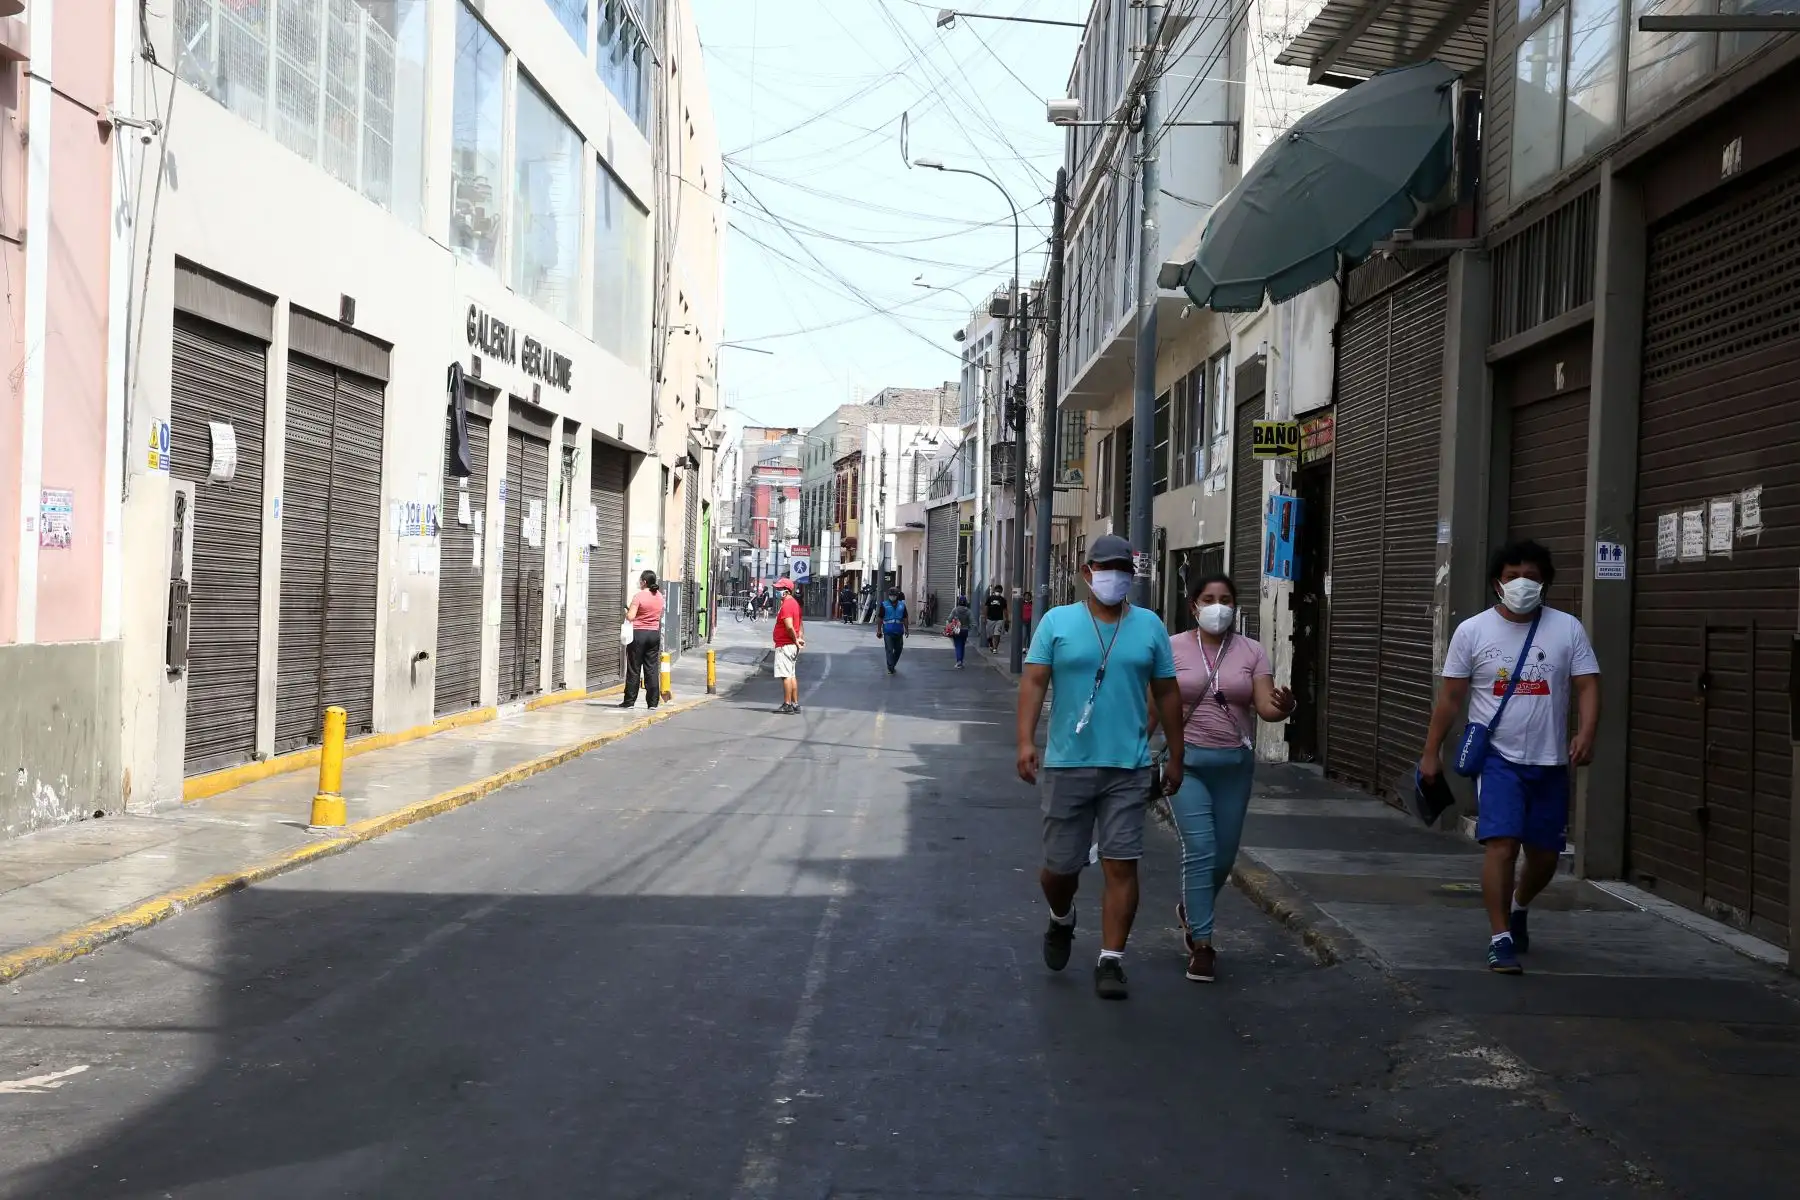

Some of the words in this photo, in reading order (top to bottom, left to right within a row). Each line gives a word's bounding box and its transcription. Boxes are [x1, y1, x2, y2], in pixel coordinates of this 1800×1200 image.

[466, 303, 516, 368] GALERIA
[521, 335, 573, 394] GERALDINE
[1253, 423, 1298, 445] BAÑO
[960, 522, 974, 531] BAÑ
[1459, 725, 1477, 768] adidas
